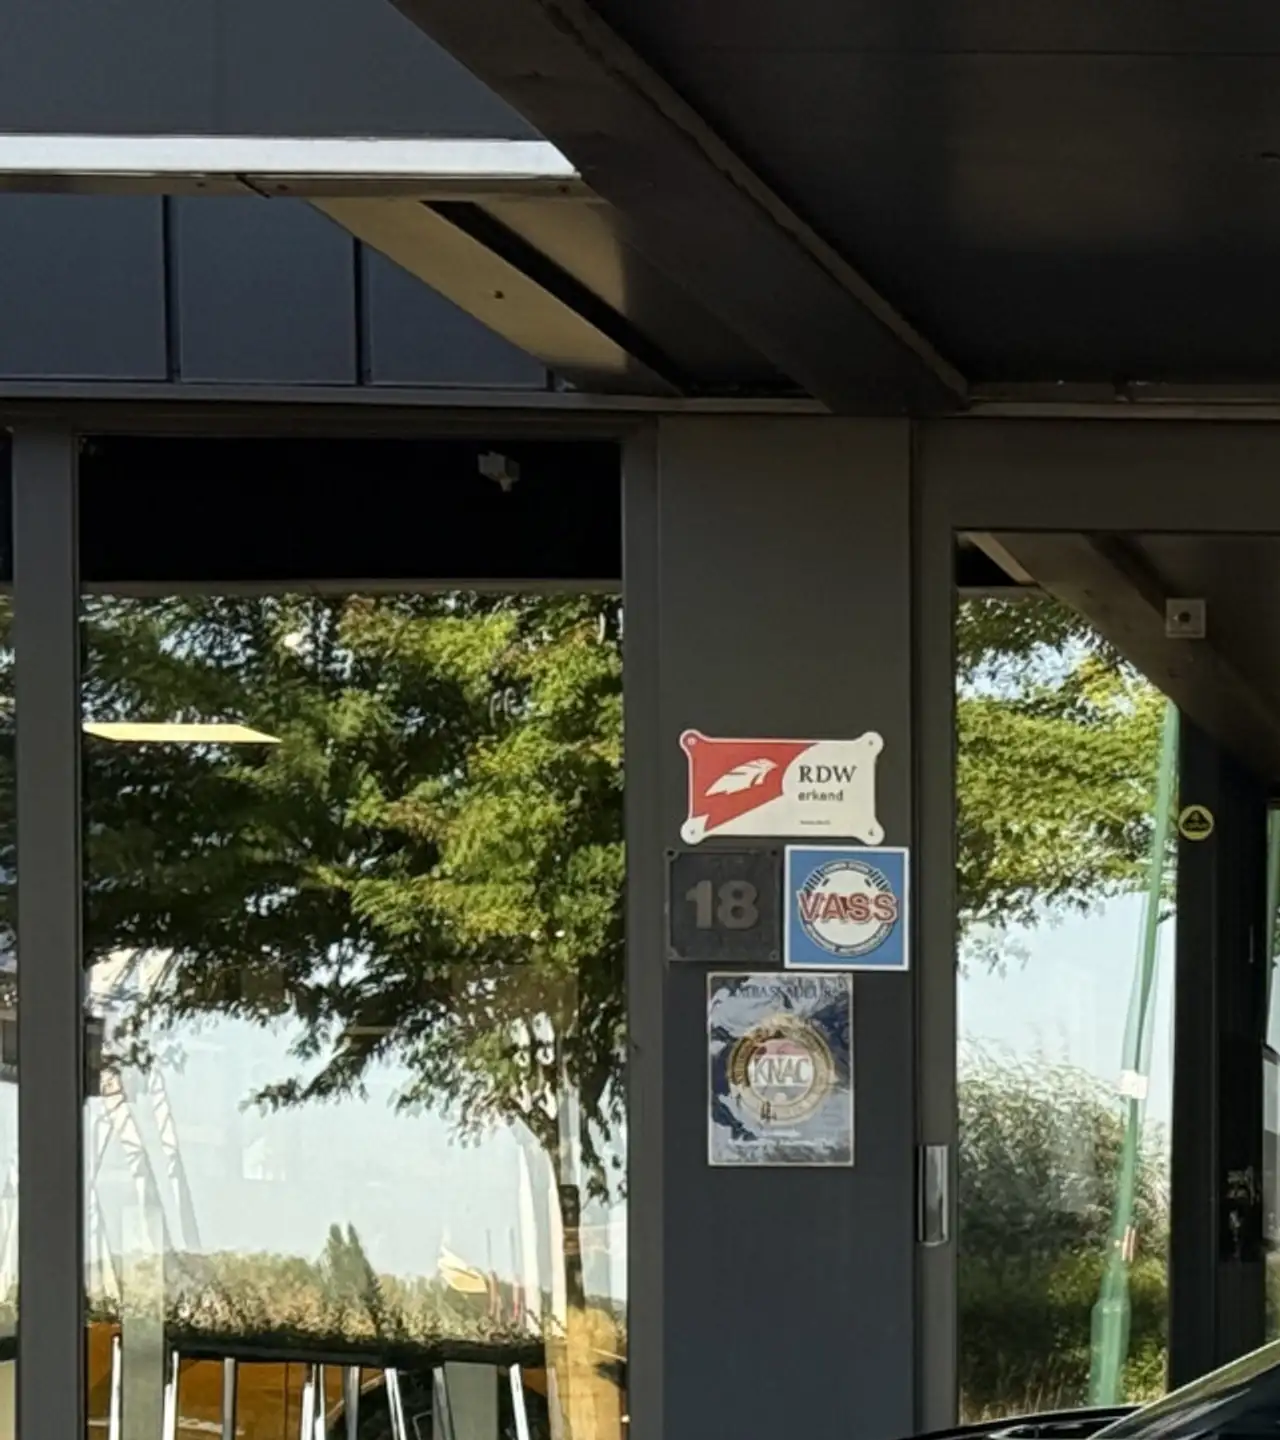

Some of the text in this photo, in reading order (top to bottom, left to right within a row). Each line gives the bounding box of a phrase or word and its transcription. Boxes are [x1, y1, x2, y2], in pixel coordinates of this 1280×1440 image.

[798, 765, 858, 783] RDW
[798, 789, 844, 801] erkend
[685, 880, 759, 930] 18
[797, 891, 899, 924] VASS
[753, 1058, 809, 1084] KNAC
